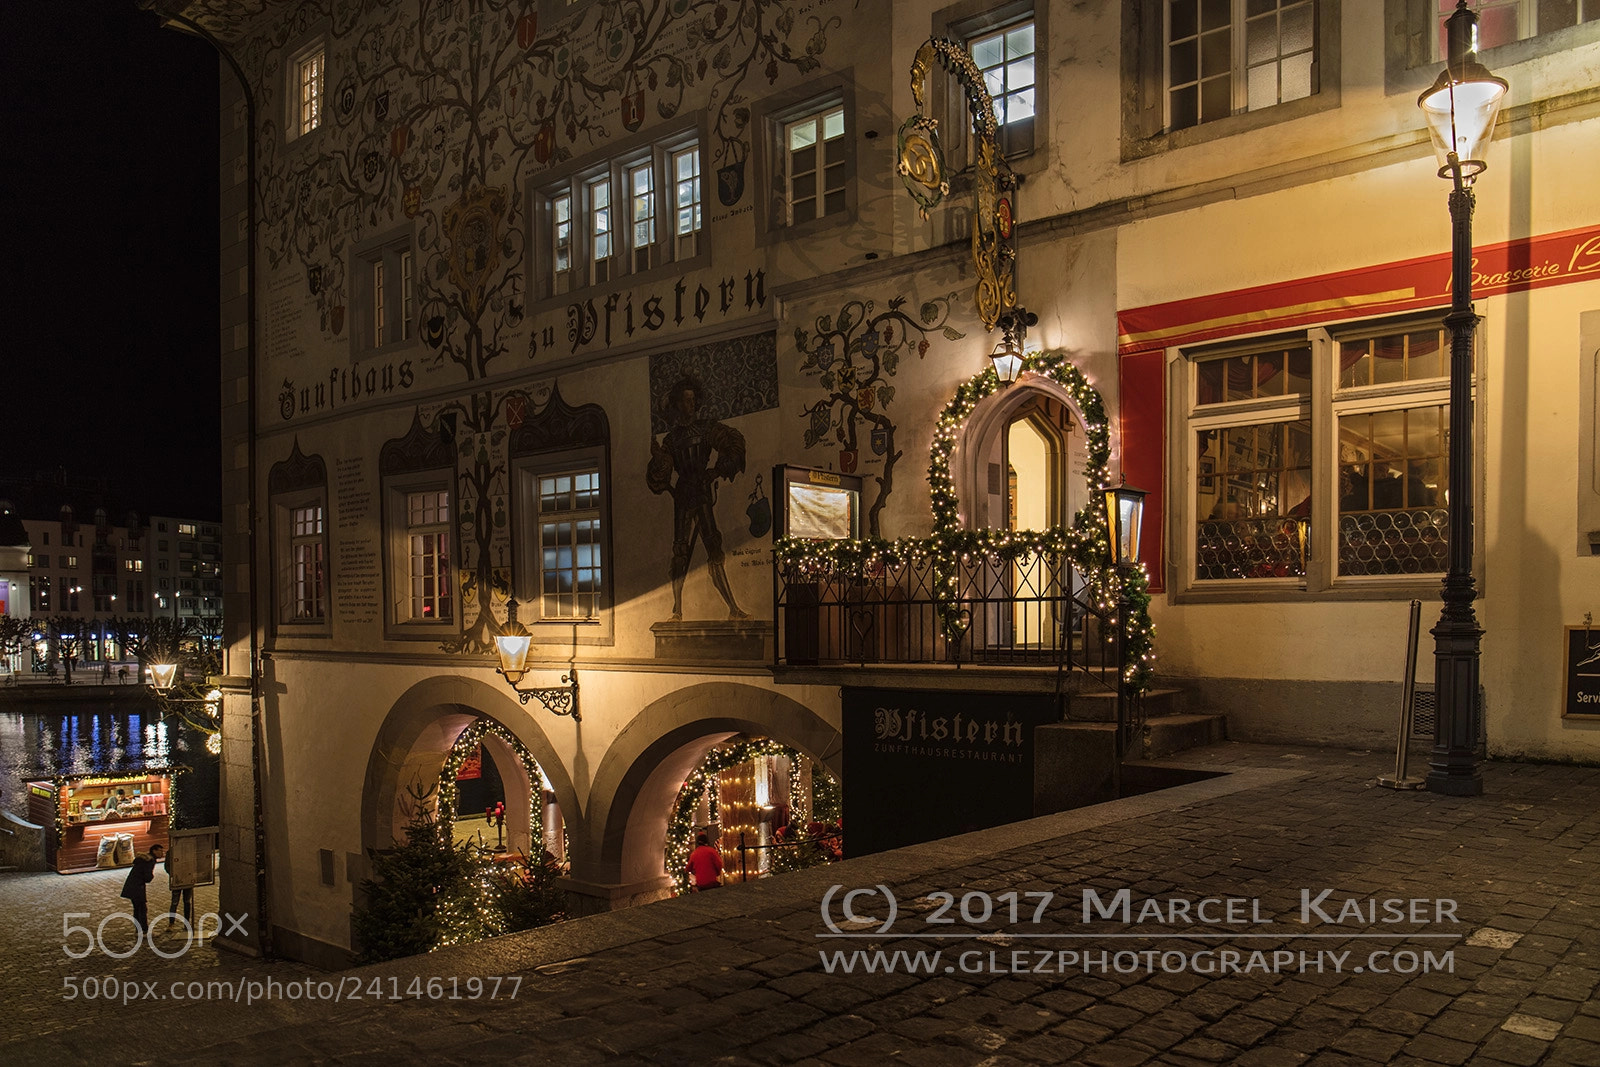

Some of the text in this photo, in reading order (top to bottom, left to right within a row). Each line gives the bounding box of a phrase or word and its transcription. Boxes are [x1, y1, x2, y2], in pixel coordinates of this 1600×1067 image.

[528, 325, 555, 360] zu
[566, 267, 768, 355] Pfistern
[874, 707, 1024, 748] Pfistern
[874, 742, 1025, 764] ZUNFTHAUSRESTAURANT
